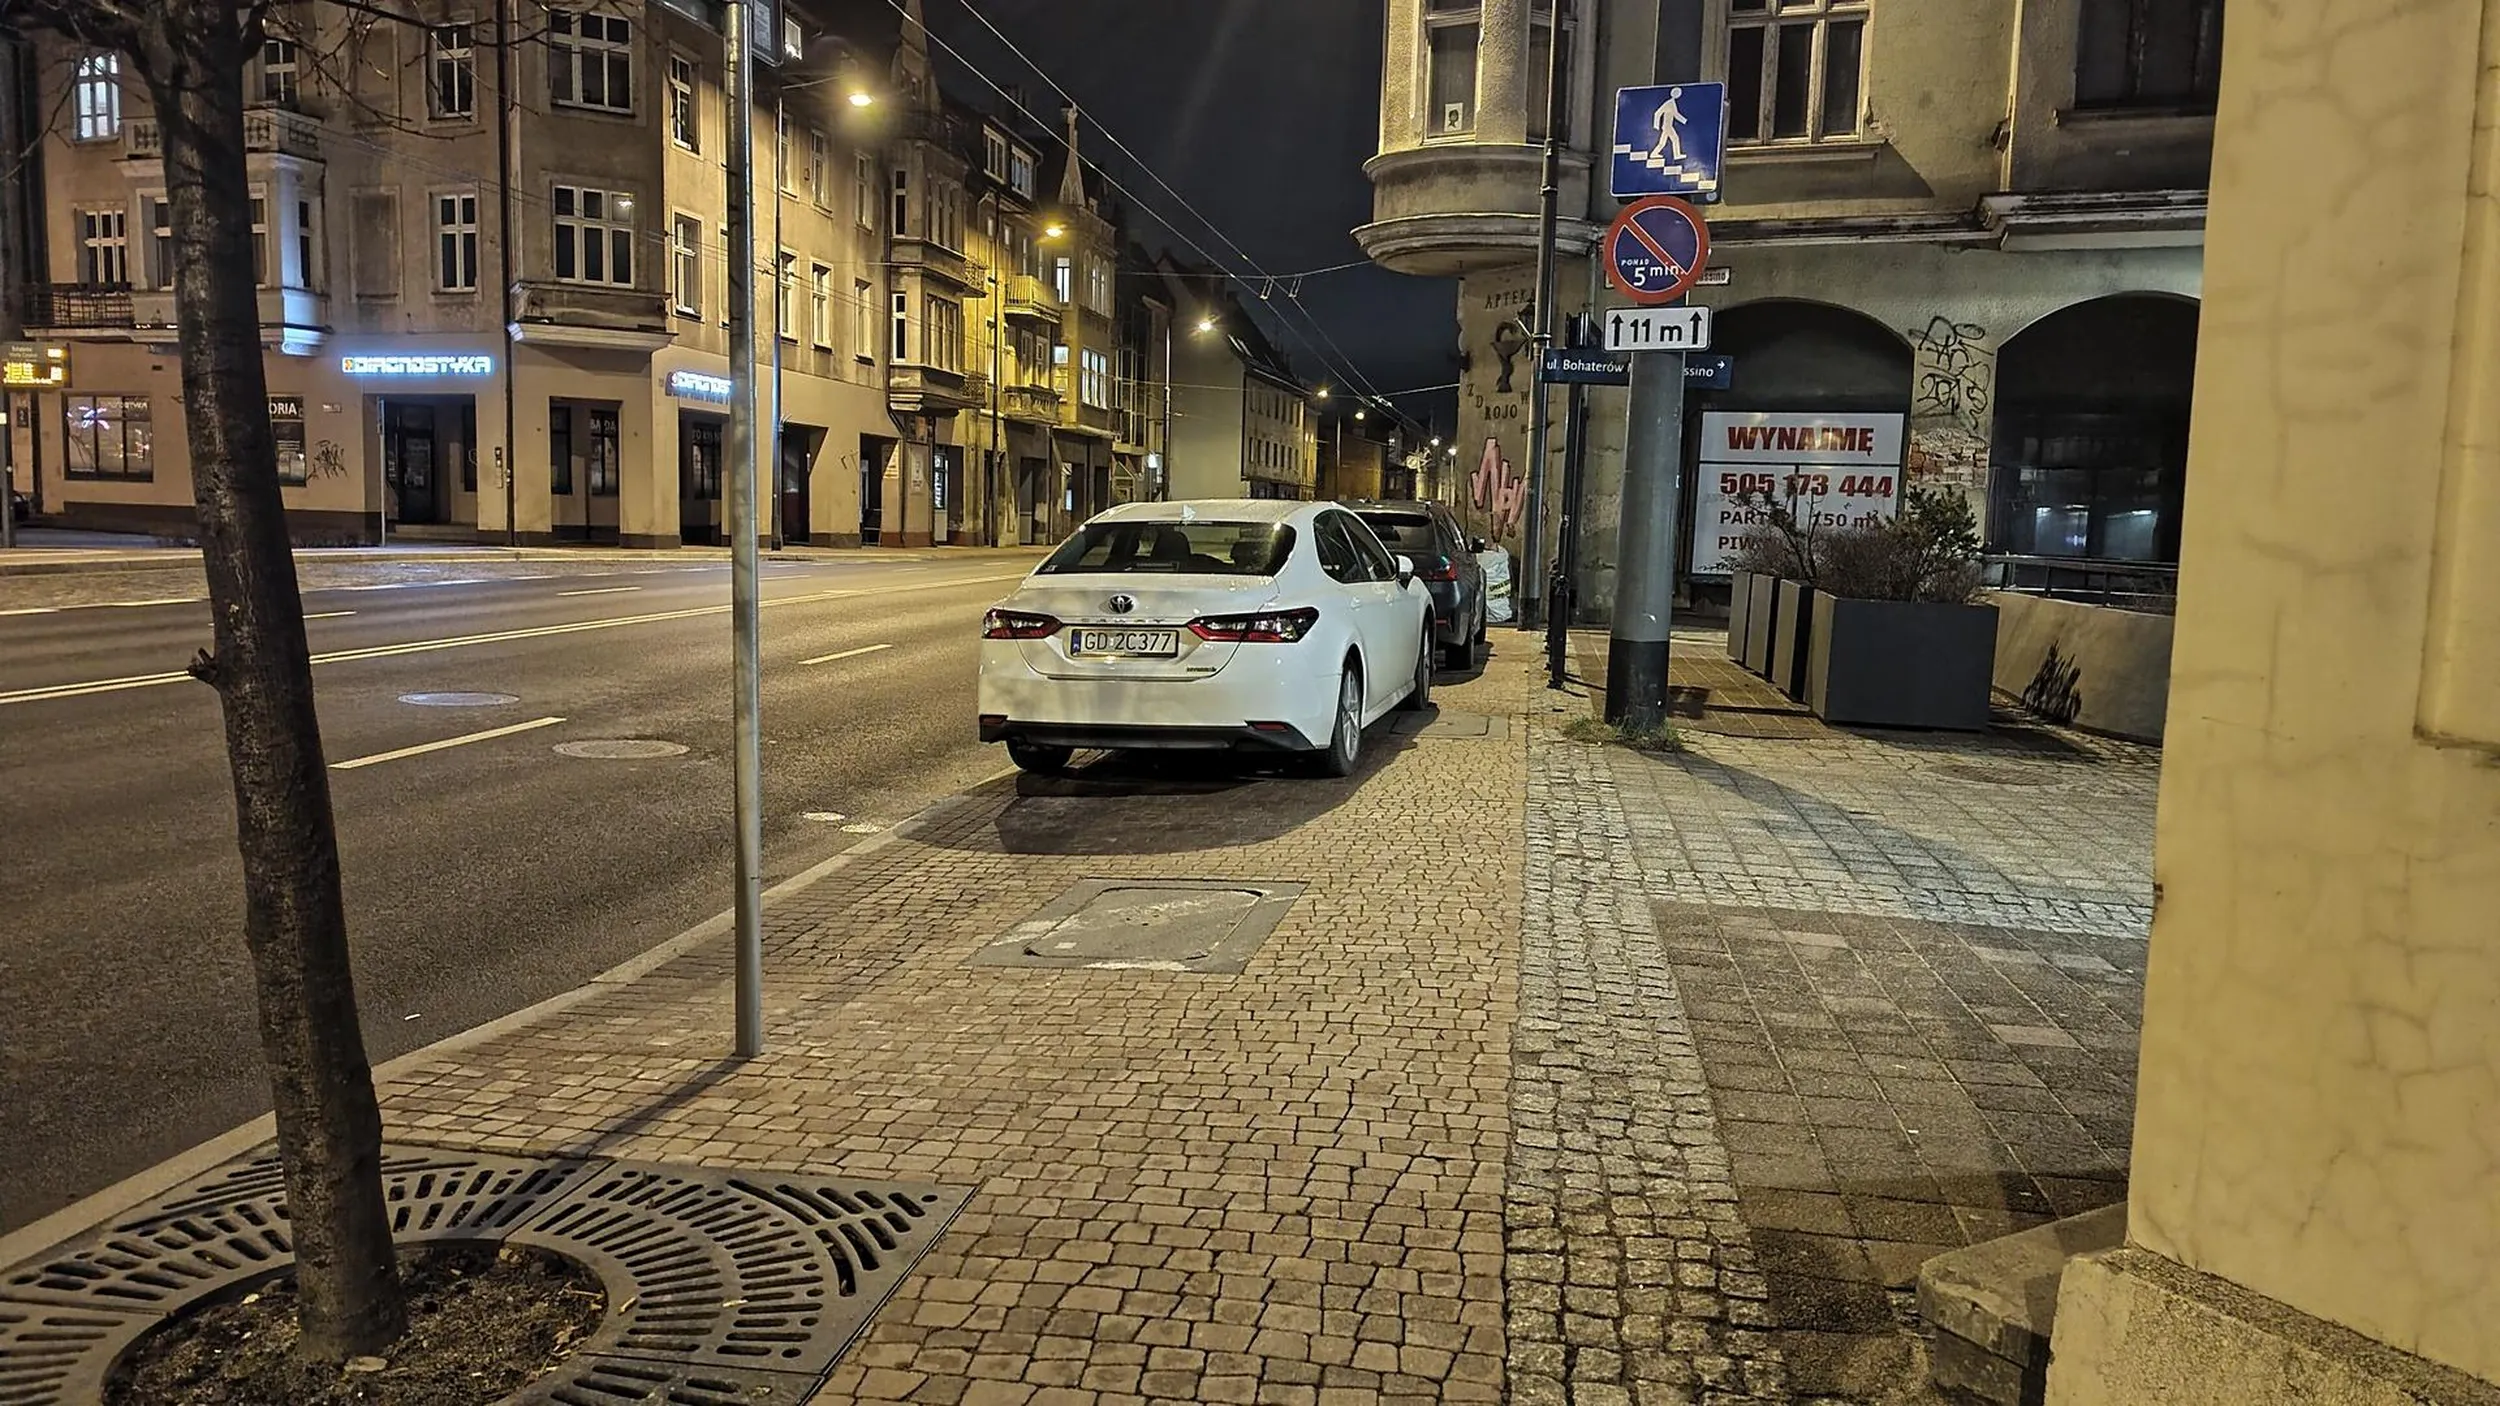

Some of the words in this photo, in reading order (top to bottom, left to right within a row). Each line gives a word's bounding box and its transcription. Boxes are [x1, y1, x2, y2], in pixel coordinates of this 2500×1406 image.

[1620, 258, 1650, 266] PONAD
[1633, 267, 1646, 287] 5
[1629, 318, 1651, 343] 11
[1660, 325, 1683, 342] m
[1563, 359, 1624, 374] Bohaterów
[1684, 367, 1714, 378] ssino
[268, 402, 297, 415] ORIA
[1727, 426, 1874, 457] WYNAJMĘ
[1720, 472, 1775, 496] 505
[1838, 474, 1893, 498] 444
[1085, 633, 1108, 650] GD
[1114, 633, 1172, 652] 2C377
